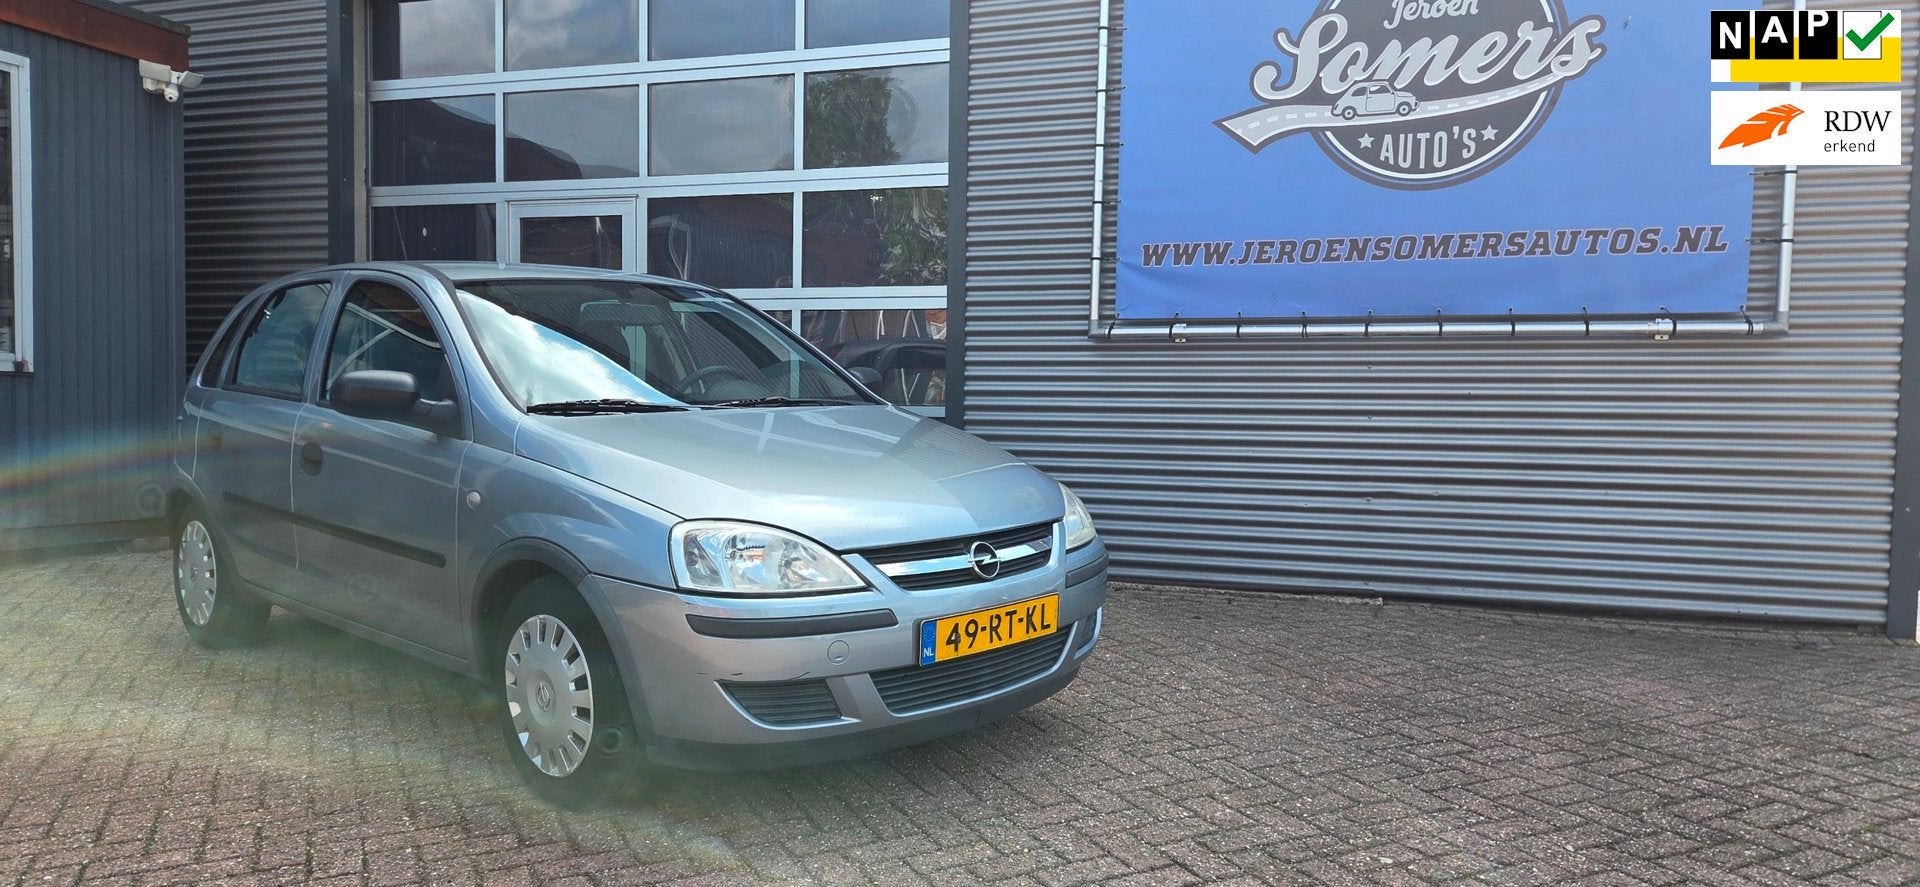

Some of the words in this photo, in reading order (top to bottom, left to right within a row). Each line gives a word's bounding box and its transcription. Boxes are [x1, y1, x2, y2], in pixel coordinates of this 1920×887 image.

[1383, 0, 1479, 29] Jeroen
[1253, 13, 1602, 100] Somers
[1379, 125, 1477, 169] AUTO'S
[1141, 226, 1728, 267] WWW.JEROENSOMERSAUTOS.NL
[923, 648, 934, 657] NL
[945, 603, 1051, 652] 49-RT-KL
